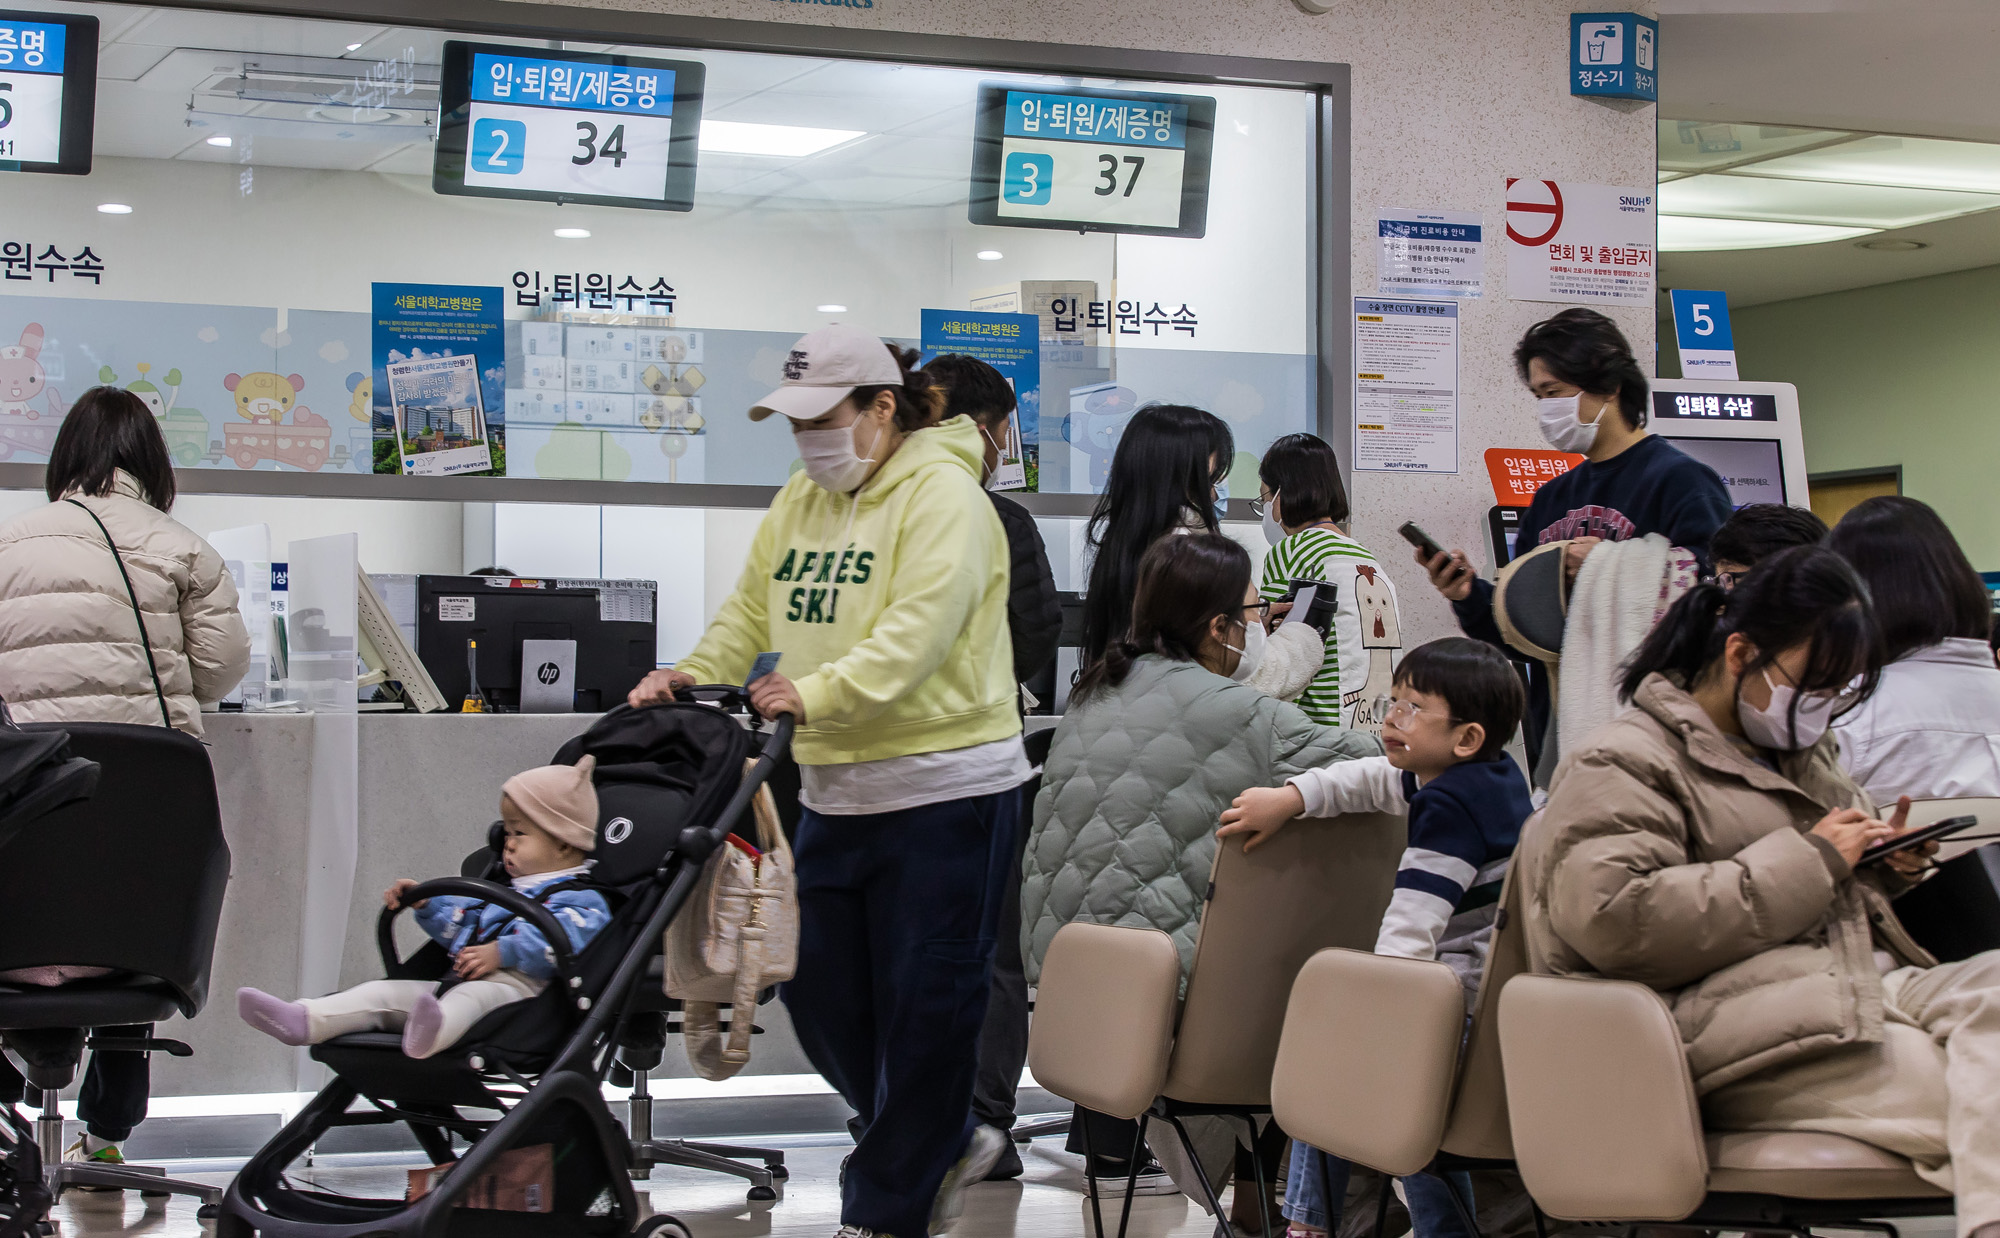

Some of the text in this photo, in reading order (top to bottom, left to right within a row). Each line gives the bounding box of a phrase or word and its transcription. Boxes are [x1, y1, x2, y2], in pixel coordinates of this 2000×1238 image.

[490, 62, 658, 110] 입·퇴원/제증명
[1578, 70, 1623, 88] 정수기
[1635, 71, 1654, 93] 정수기
[1020, 99, 1172, 142] 입·퇴원/제증명
[487, 129, 510, 167] 2
[571, 121, 627, 168] 34
[1018, 162, 1039, 198] 3
[1094, 153, 1145, 198] 37
[1619, 196, 1645, 206] SNUH
[1451, 228, 1466, 237] 안내
[1549, 243, 1652, 267] 면회 및 출입금지
[1573, 267, 1592, 275] 코로나19
[394, 295, 483, 311] 서울대학교병원은
[512, 270, 677, 314] 입·퇴원수속
[1050, 297, 1199, 338] 입·퇴원수속
[1395, 304, 1414, 313] CCTV
[1691, 303, 1715, 336] 5
[941, 321, 1021, 337] 서울대학교병원은
[1675, 395, 1754, 417] 입퇴원 수납
[1503, 457, 1570, 477] 입원·퇴원
[773, 542, 875, 584] APRÉS
[786, 587, 840, 624] SKI
[538, 662, 560, 685] hp
